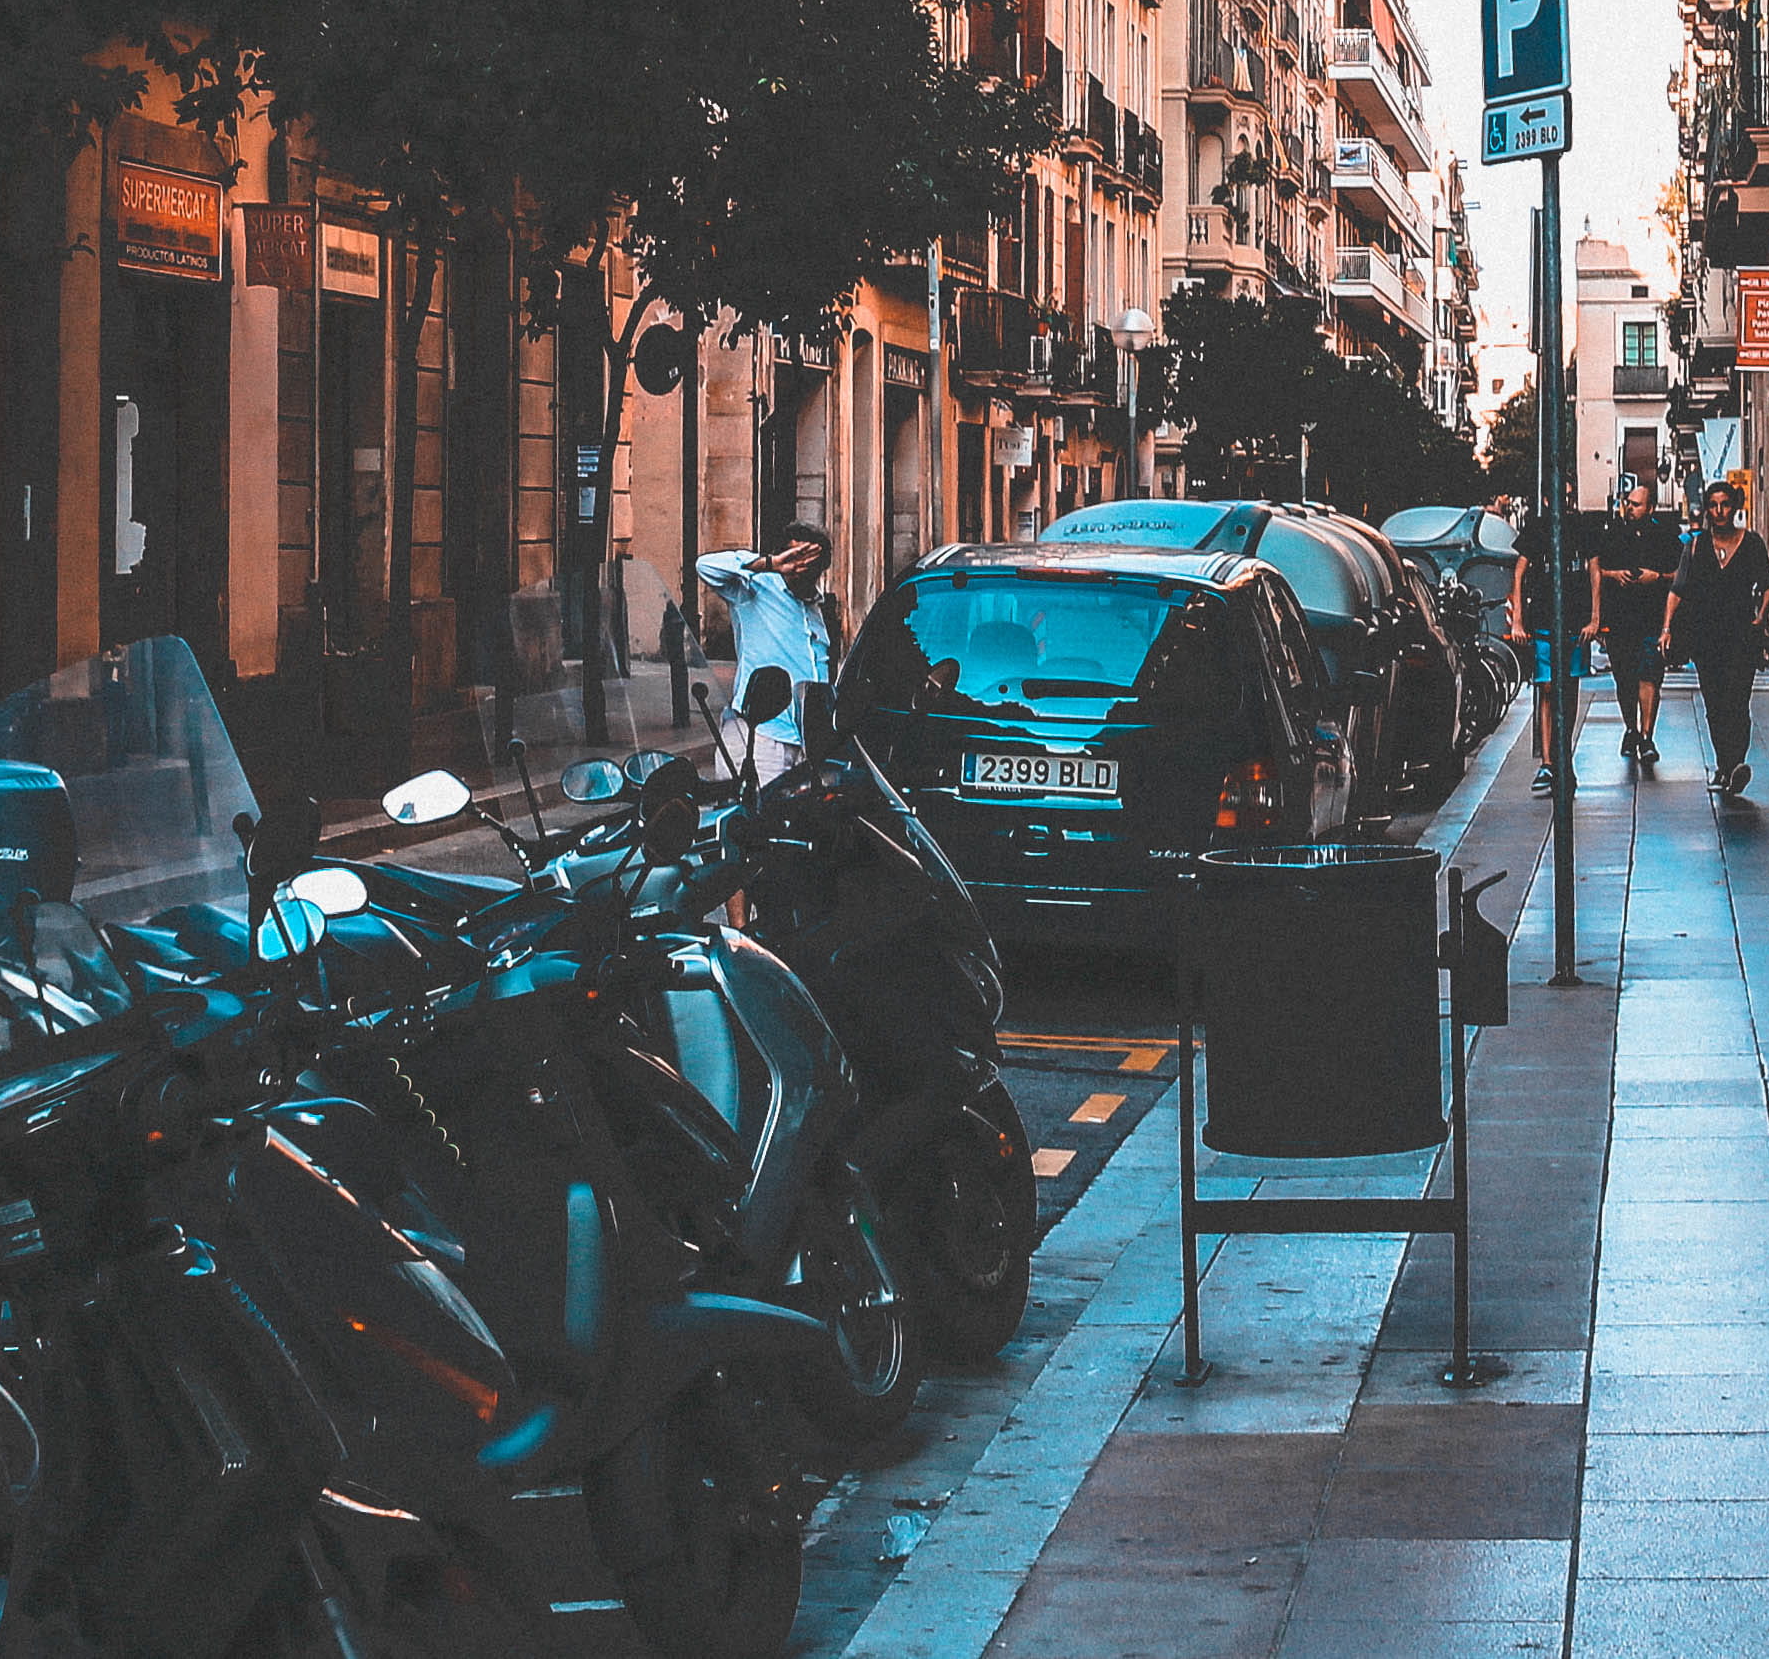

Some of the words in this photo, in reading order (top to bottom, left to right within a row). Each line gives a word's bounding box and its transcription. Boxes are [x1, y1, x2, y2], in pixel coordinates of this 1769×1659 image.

[1515, 128, 1537, 150] 2399
[122, 177, 207, 222] SUPERMERCAT
[250, 213, 304, 234] SUPER
[126, 245, 175, 263] PRODUCTOS
[176, 255, 208, 269] LATINOS
[980, 756, 1050, 785] 2399
[1059, 760, 1112, 788] BLD
